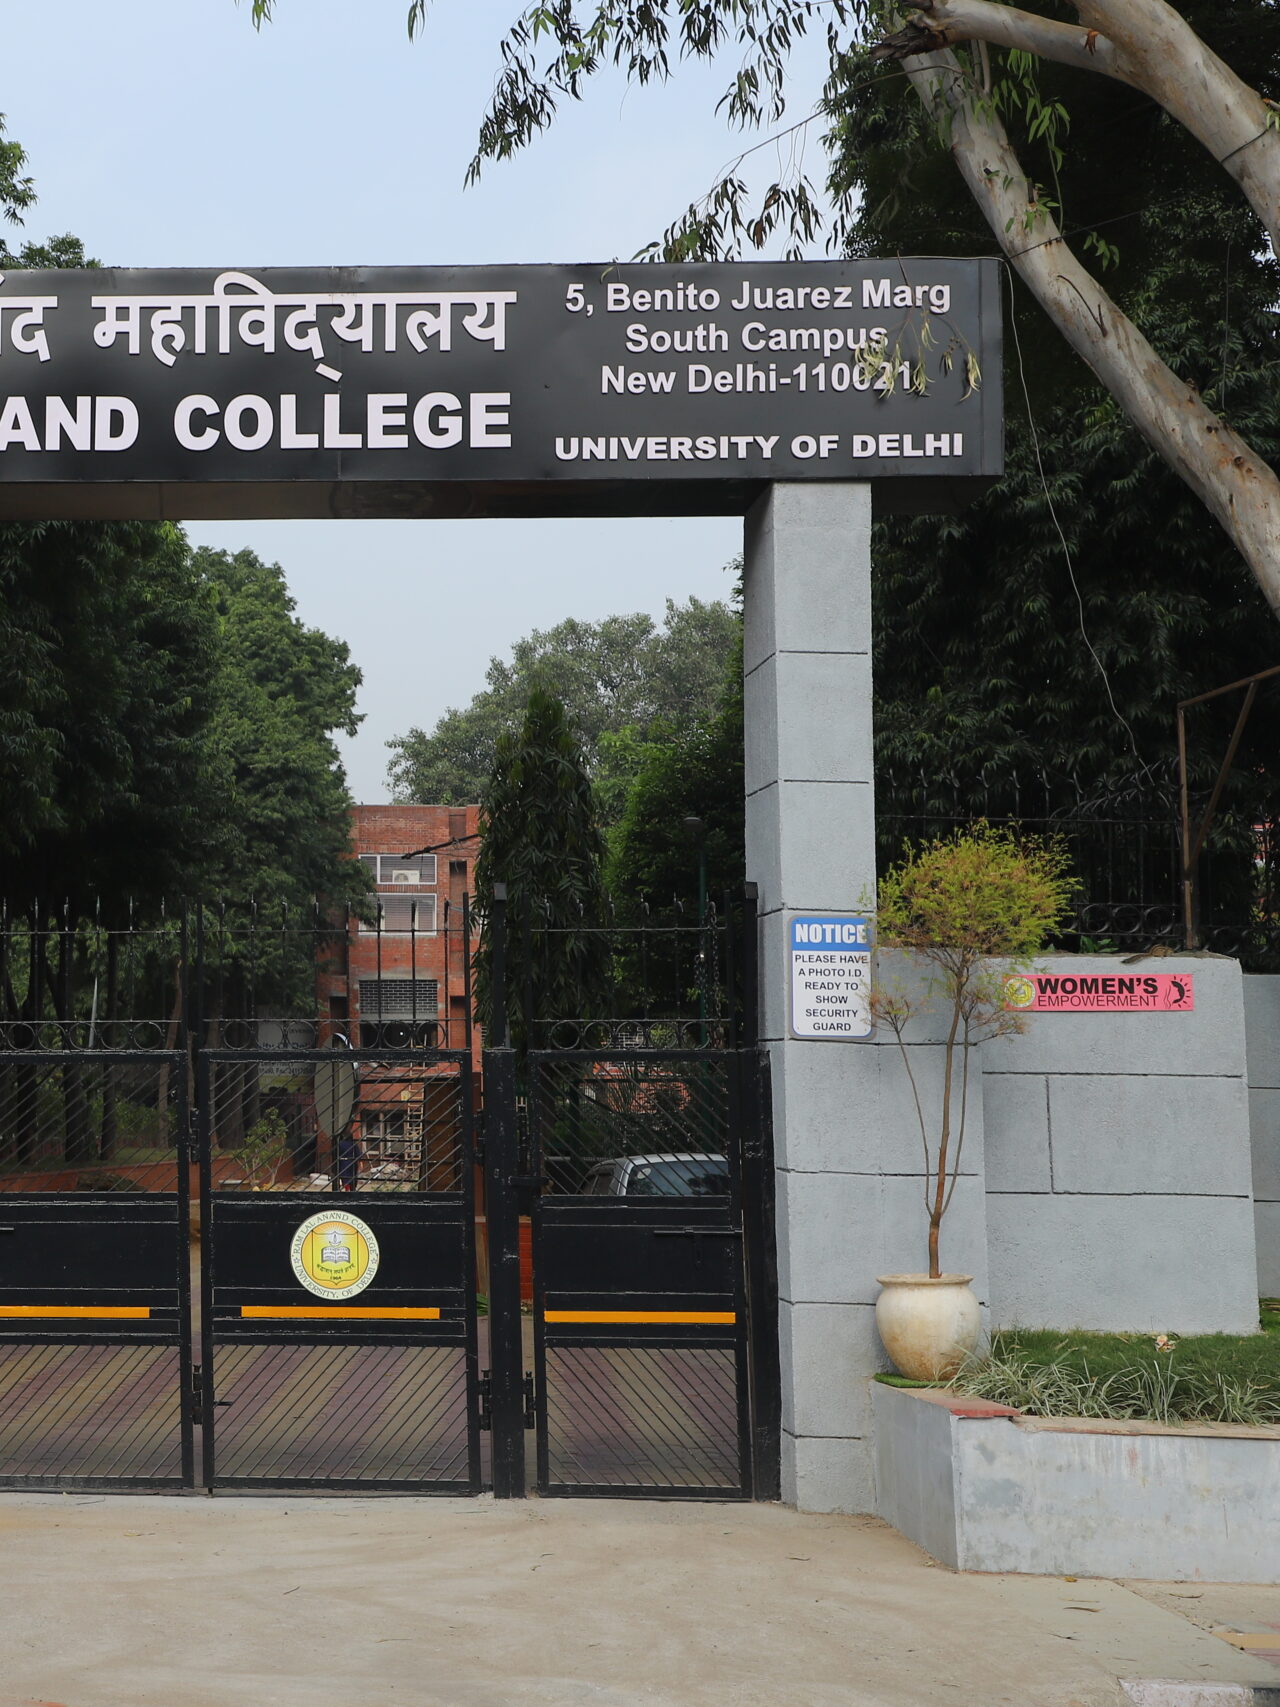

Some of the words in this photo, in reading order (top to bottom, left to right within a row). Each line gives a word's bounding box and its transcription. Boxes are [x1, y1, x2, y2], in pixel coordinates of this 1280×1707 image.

[566, 284, 593, 316] 5,
[608, 283, 721, 311] Benito
[732, 281, 853, 310] Juarez
[863, 279, 951, 314] Marg
[92, 272, 517, 381] महाविद्यालय
[626, 324, 729, 352] South
[742, 322, 889, 362] Campus
[602, 365, 677, 393] New
[689, 360, 911, 393] Delhi-110021
[174, 392, 512, 451] COLLEGE
[556, 436, 779, 460] UNIVERSITY
[792, 435, 839, 458] OF
[853, 434, 963, 457] DELHI
[795, 923, 868, 944] NOTICE
[794, 954, 836, 964] PLEASE
[839, 955, 868, 964] HAVE
[798, 968, 806, 976] A
[808, 968, 846, 977] PHOTO
[848, 968, 865, 977] I.D.
[804, 982, 842, 991] READY
[844, 982, 859, 991] TO
[1037, 977, 1158, 995] WOMEN'S
[815, 995, 849, 1004] SHOW
[1037, 995, 1159, 1008] EMPOWERMENT
[805, 1008, 859, 1018] SECURITY
[812, 1022, 852, 1032] GUARD
[293, 1234, 303, 1254] RAM
[302, 1221, 316, 1235] LAL
[316, 1212, 349, 1223] ANAND
[351, 1218, 377, 1255] COLLEGE
[341, 1288, 354, 1298] OF
[356, 1267, 376, 1290] DELHI
